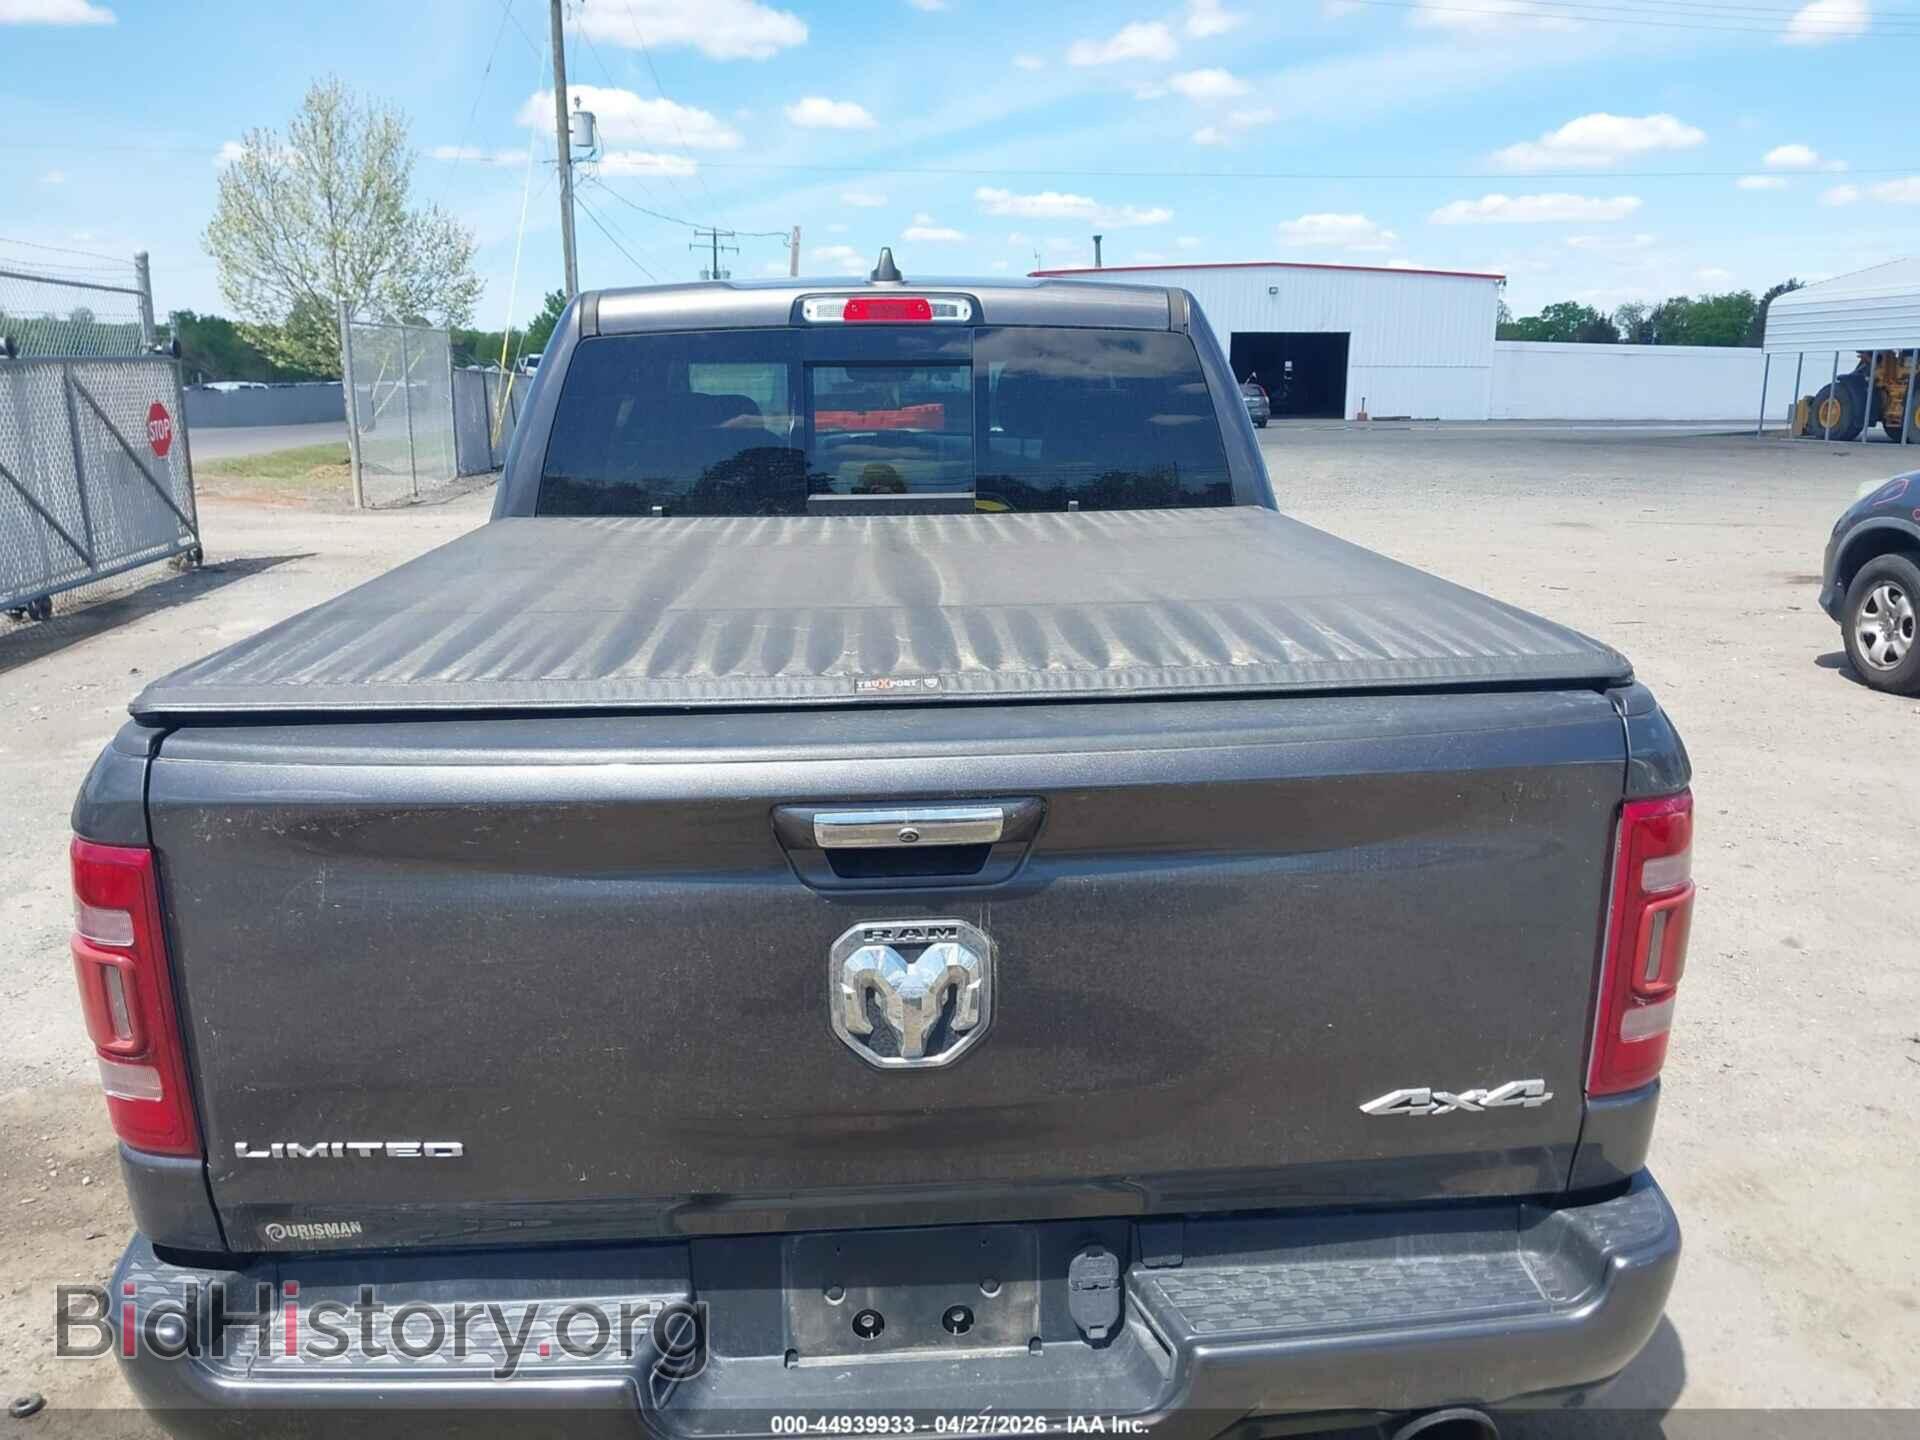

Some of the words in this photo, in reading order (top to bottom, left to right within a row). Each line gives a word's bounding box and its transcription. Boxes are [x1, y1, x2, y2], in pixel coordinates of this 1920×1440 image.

[150, 418, 170, 441] STOP
[863, 927, 957, 941] RAM
[234, 1142, 463, 1158] LIMITED
